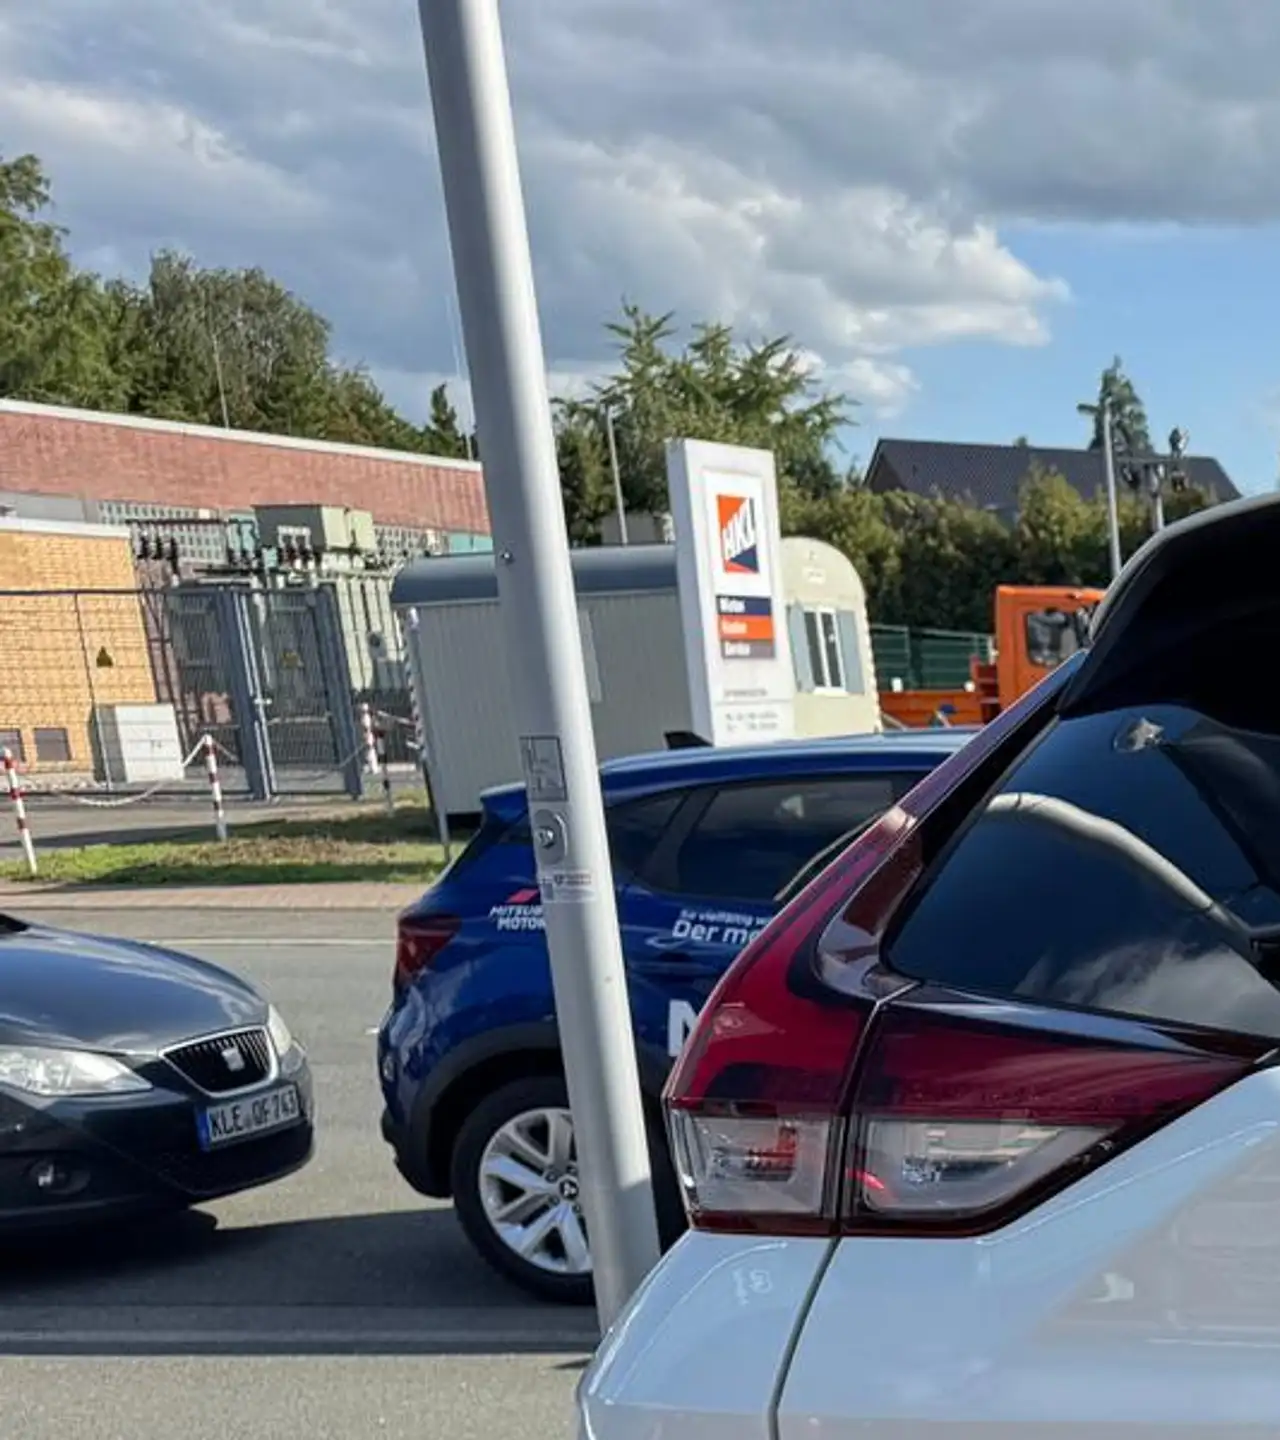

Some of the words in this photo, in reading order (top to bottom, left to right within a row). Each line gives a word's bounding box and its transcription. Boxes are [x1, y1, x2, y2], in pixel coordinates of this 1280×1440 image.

[488, 904, 543, 918] MITSUB
[497, 916, 547, 931] MOTOR
[672, 919, 719, 942] Der
[208, 1104, 244, 1138] KLE
